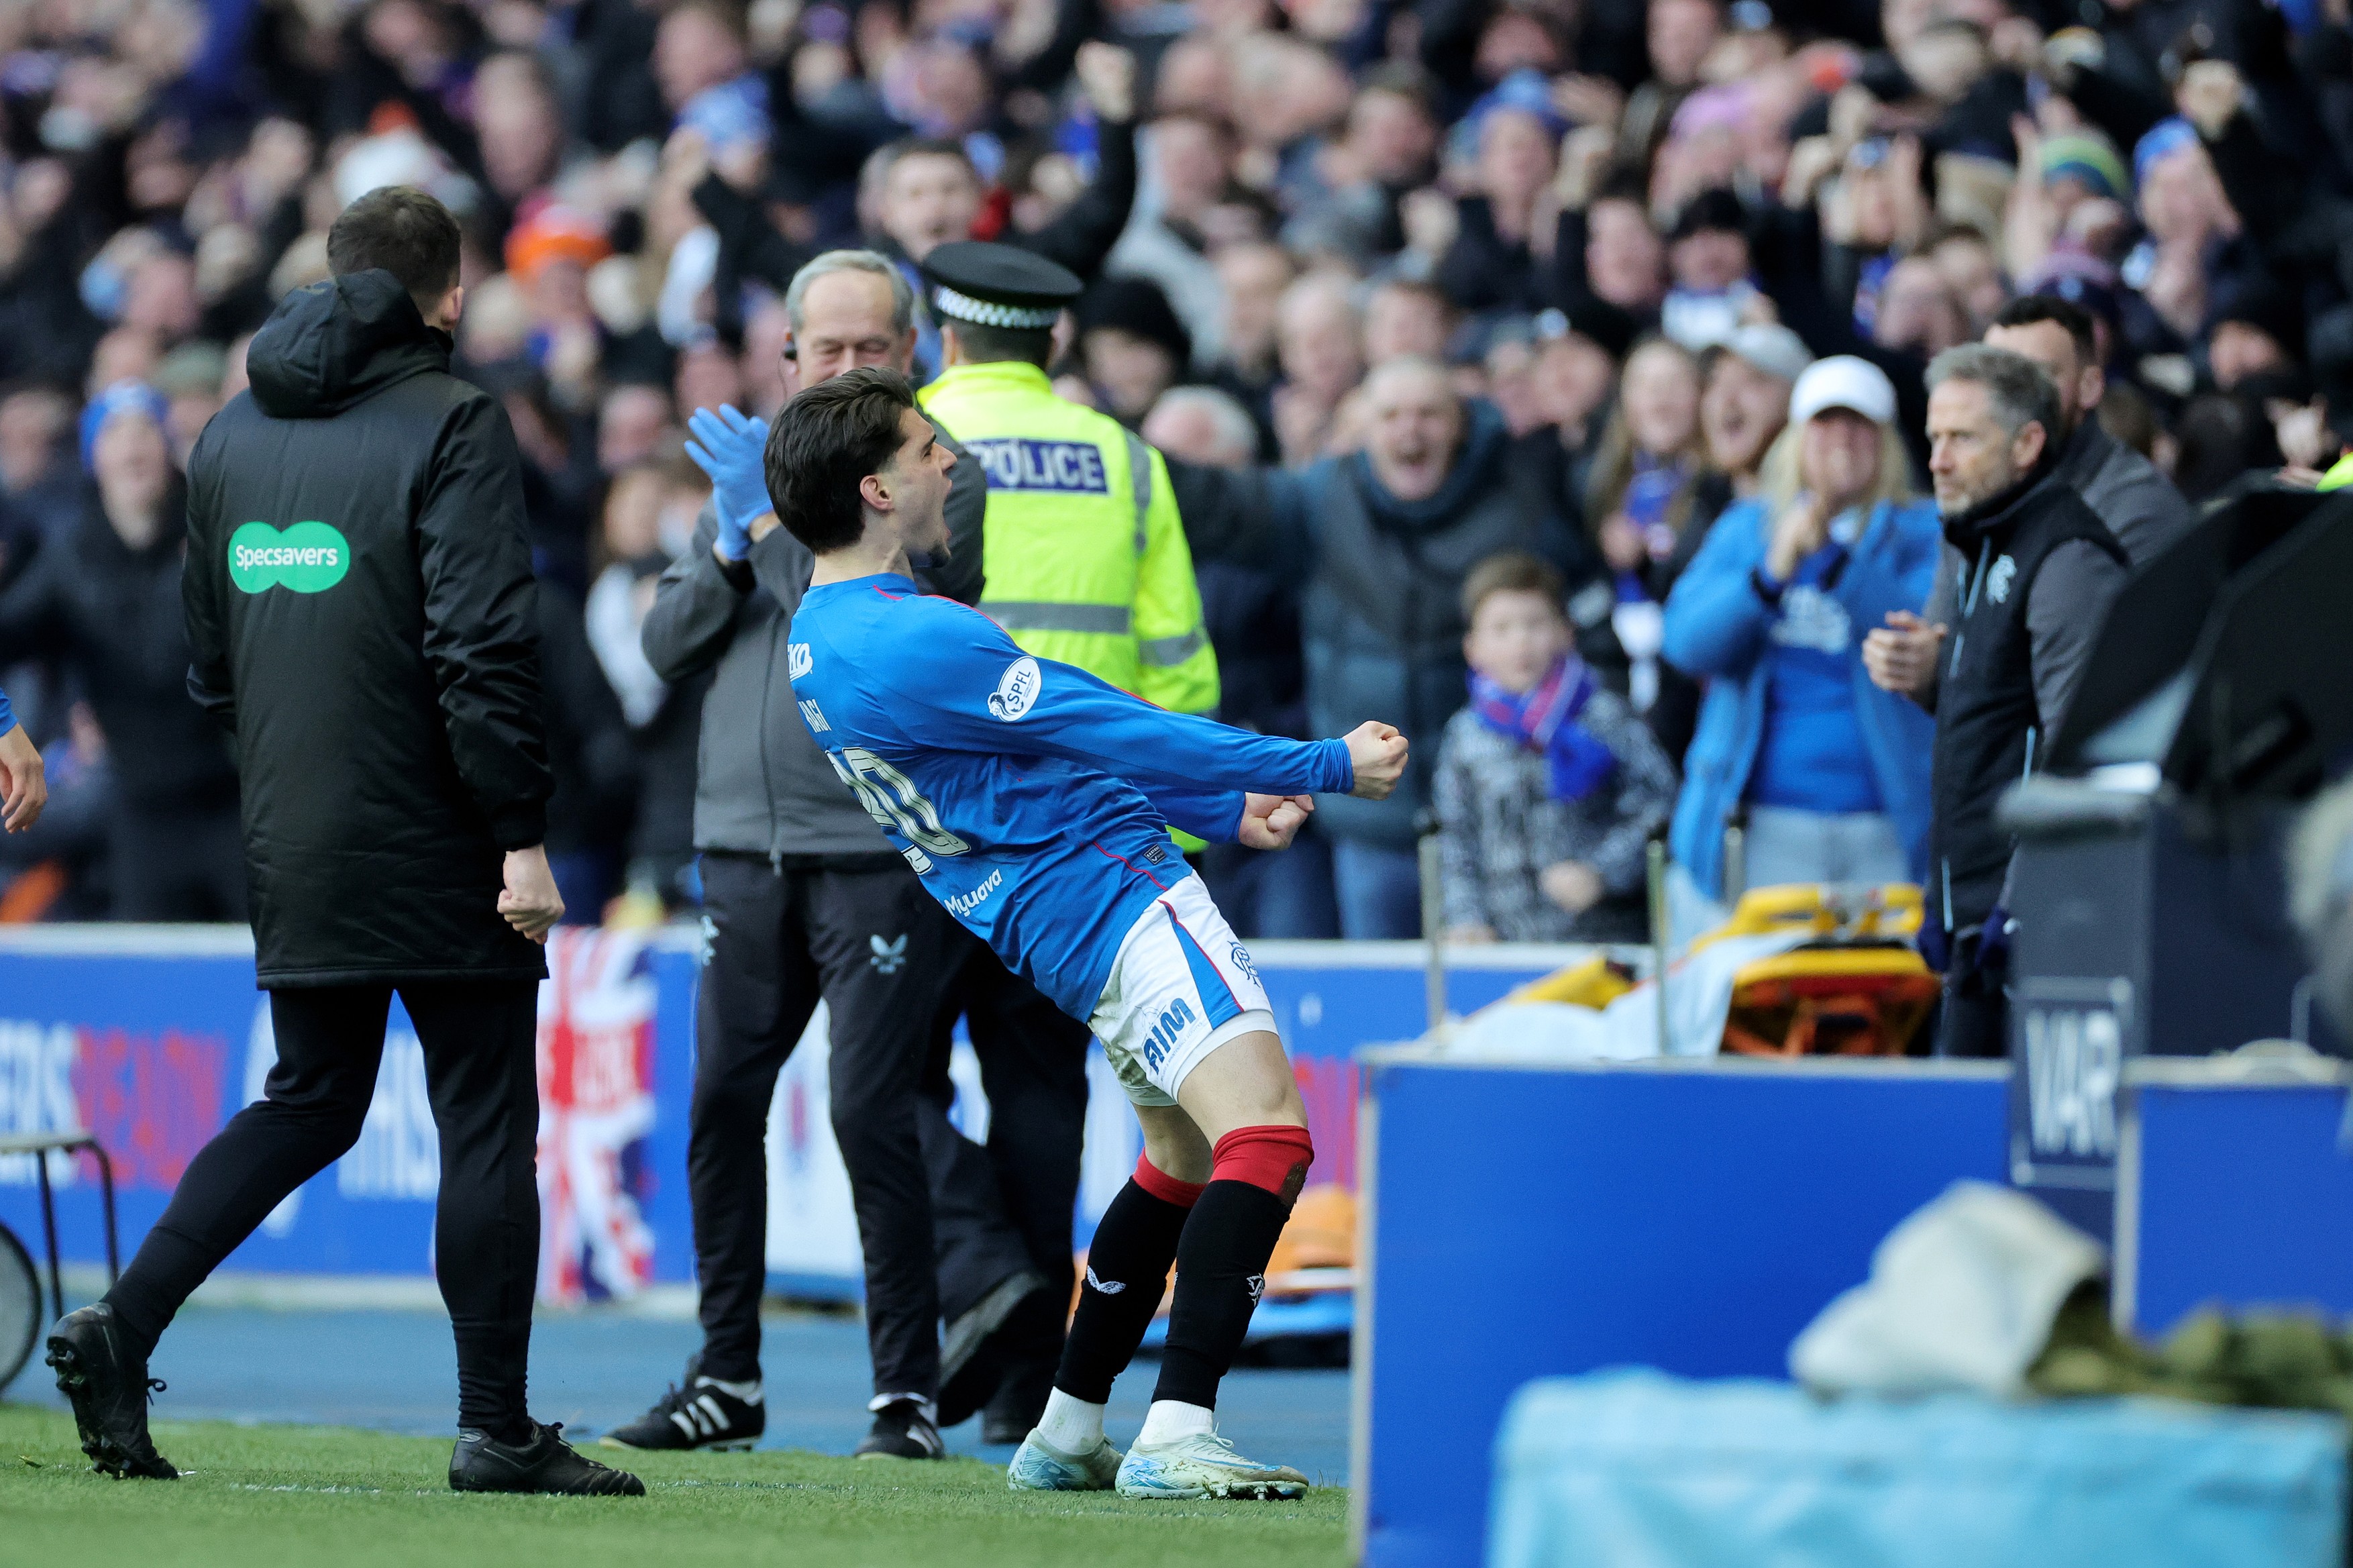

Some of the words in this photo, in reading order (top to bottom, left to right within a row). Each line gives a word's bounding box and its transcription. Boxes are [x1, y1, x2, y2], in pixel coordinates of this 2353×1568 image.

[964, 441, 1104, 487] POLICE
[236, 544, 338, 572] Specsavers
[1007, 671, 1031, 704] SPFL
[1143, 998, 1196, 1076] AIM
